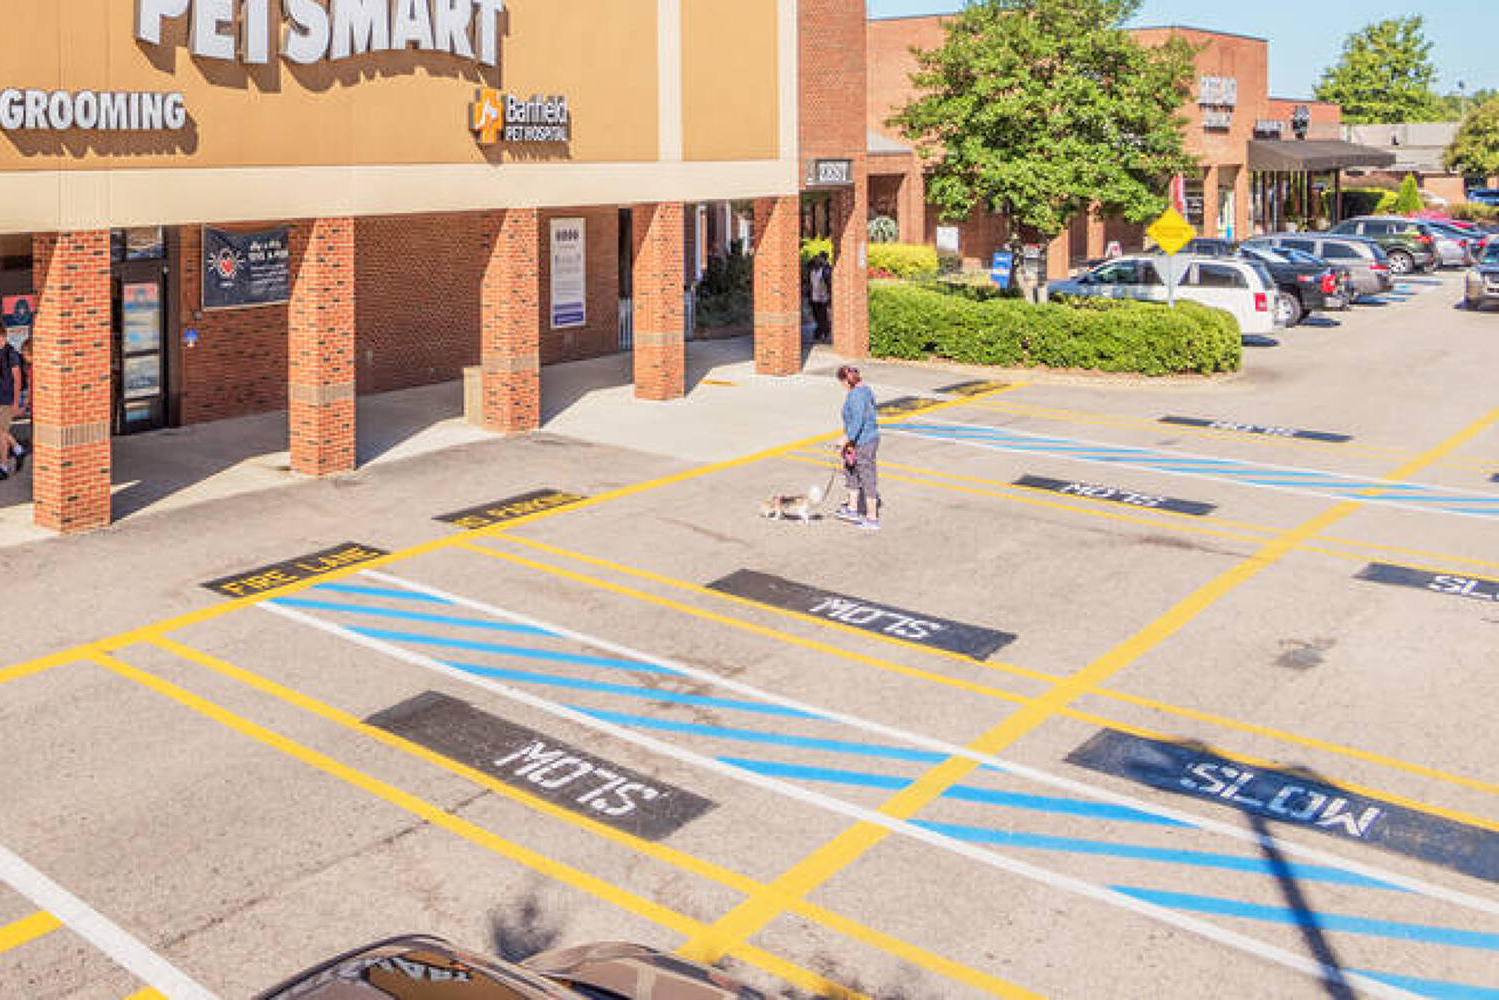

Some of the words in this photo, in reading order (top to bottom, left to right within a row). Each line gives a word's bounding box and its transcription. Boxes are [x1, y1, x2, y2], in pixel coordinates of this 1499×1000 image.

[220, 569, 300, 596] FIRE
[298, 546, 381, 574] LANE
[807, 596, 943, 640] SLOW
[494, 741, 660, 816] SLOW
[1180, 762, 1383, 838] SLOW
